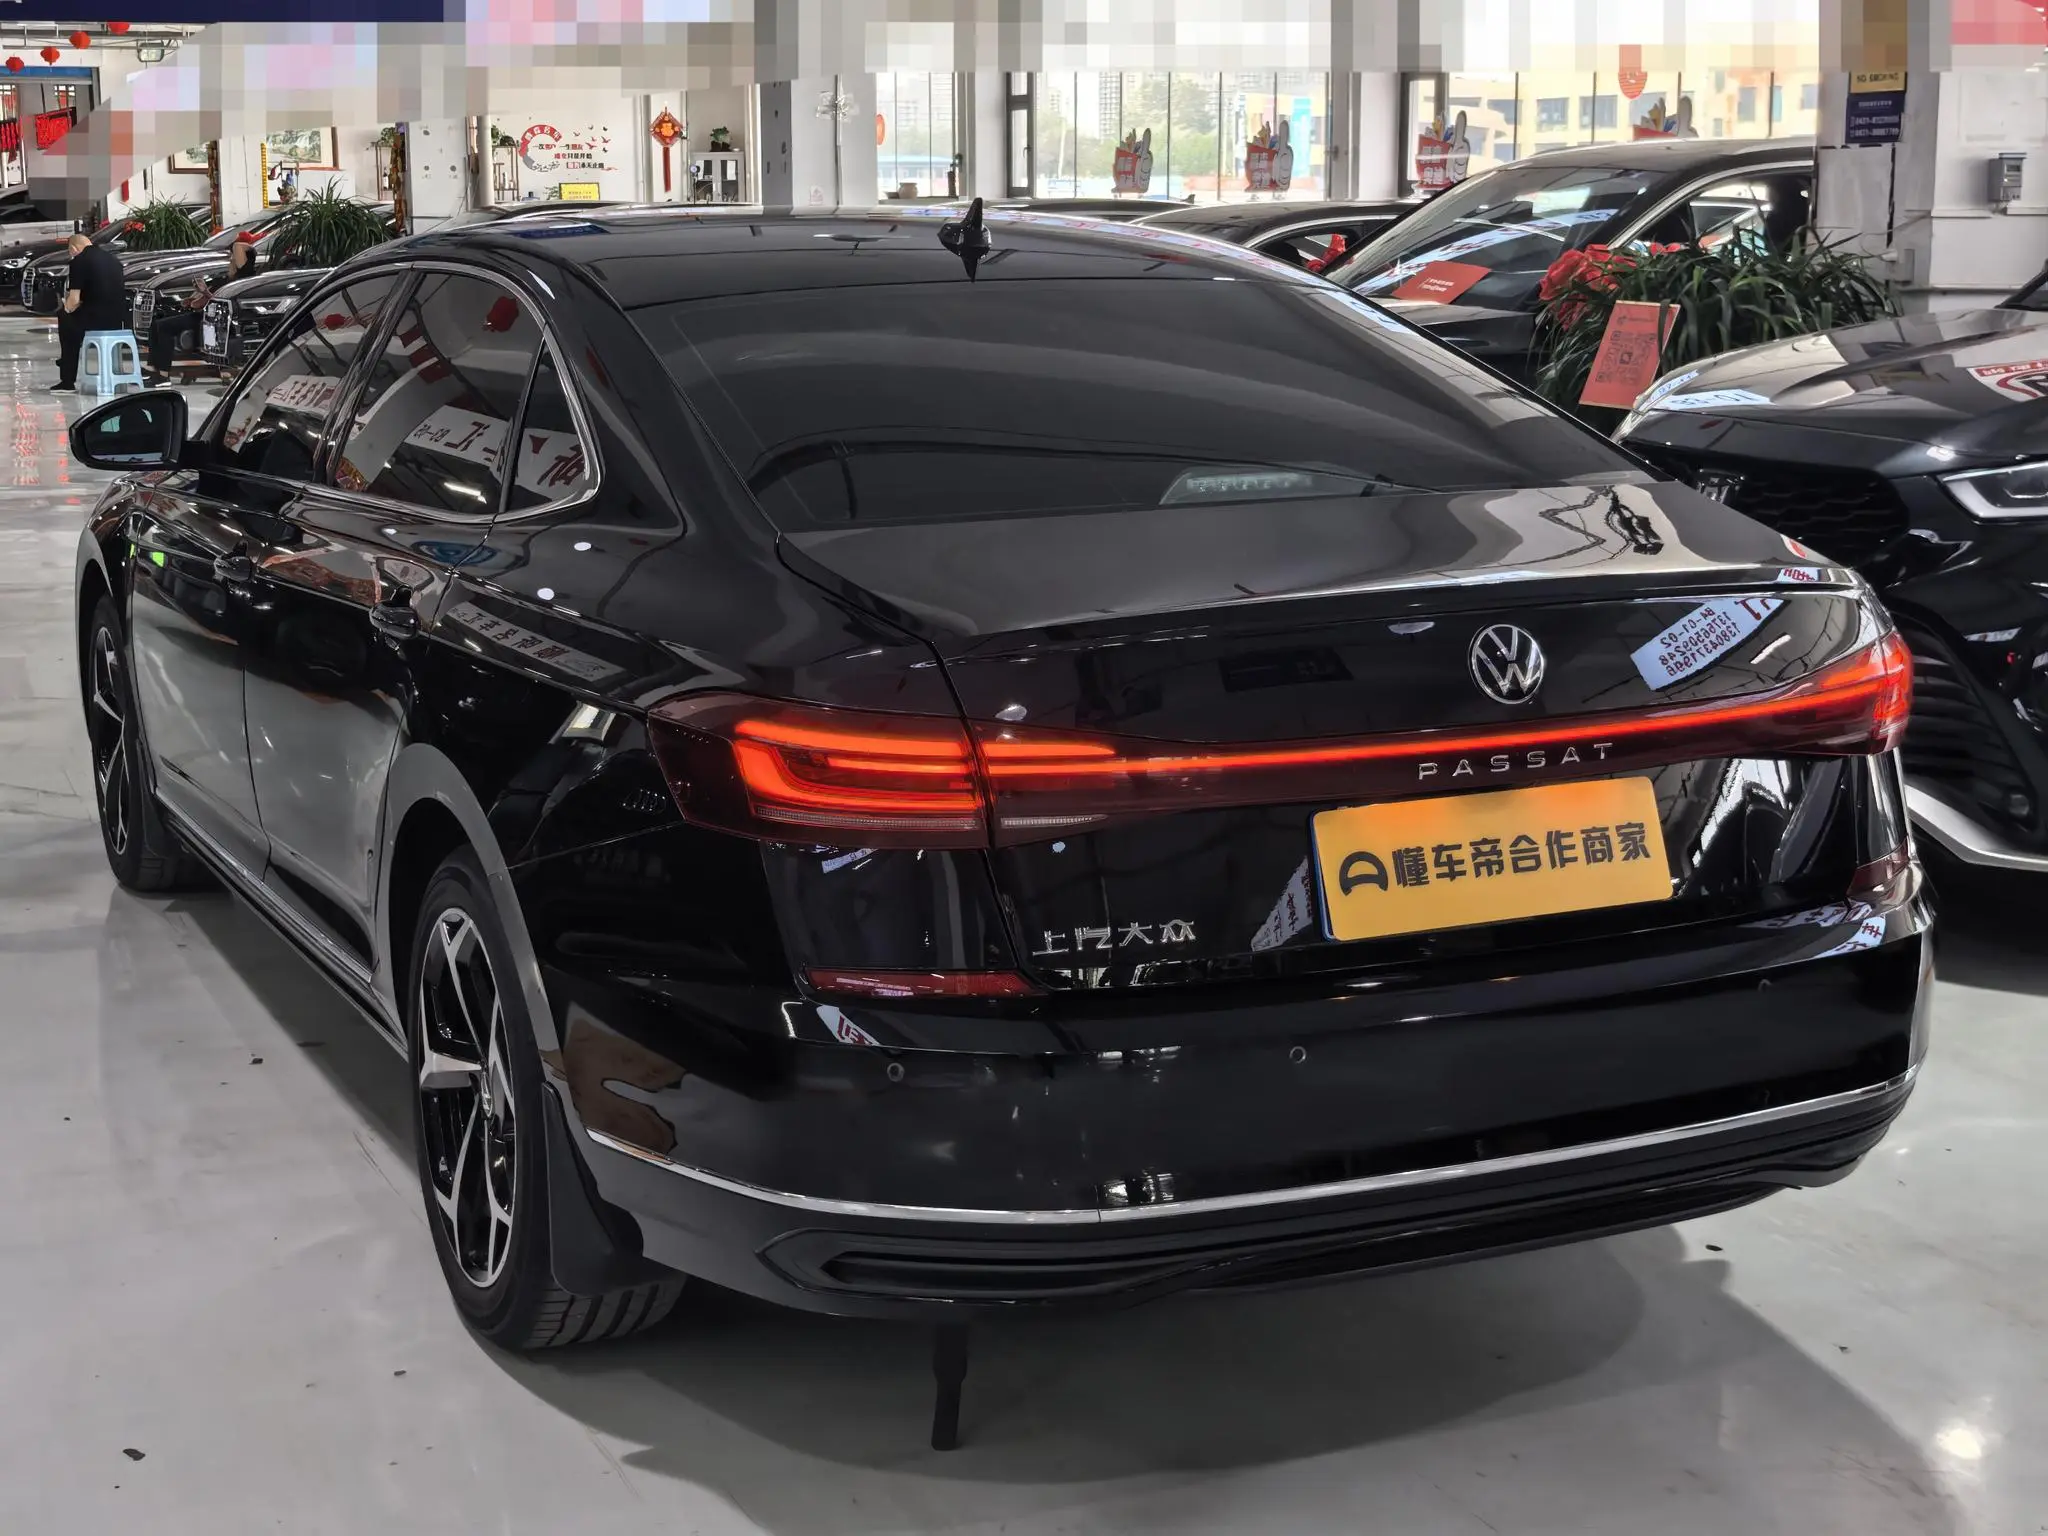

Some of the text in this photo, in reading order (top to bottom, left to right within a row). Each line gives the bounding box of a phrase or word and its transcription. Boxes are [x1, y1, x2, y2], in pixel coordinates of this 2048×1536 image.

[1471, 624, 1544, 704] VW
[1418, 742, 1614, 781] PASSAT
[1032, 919, 1197, 956] 上汽大众
